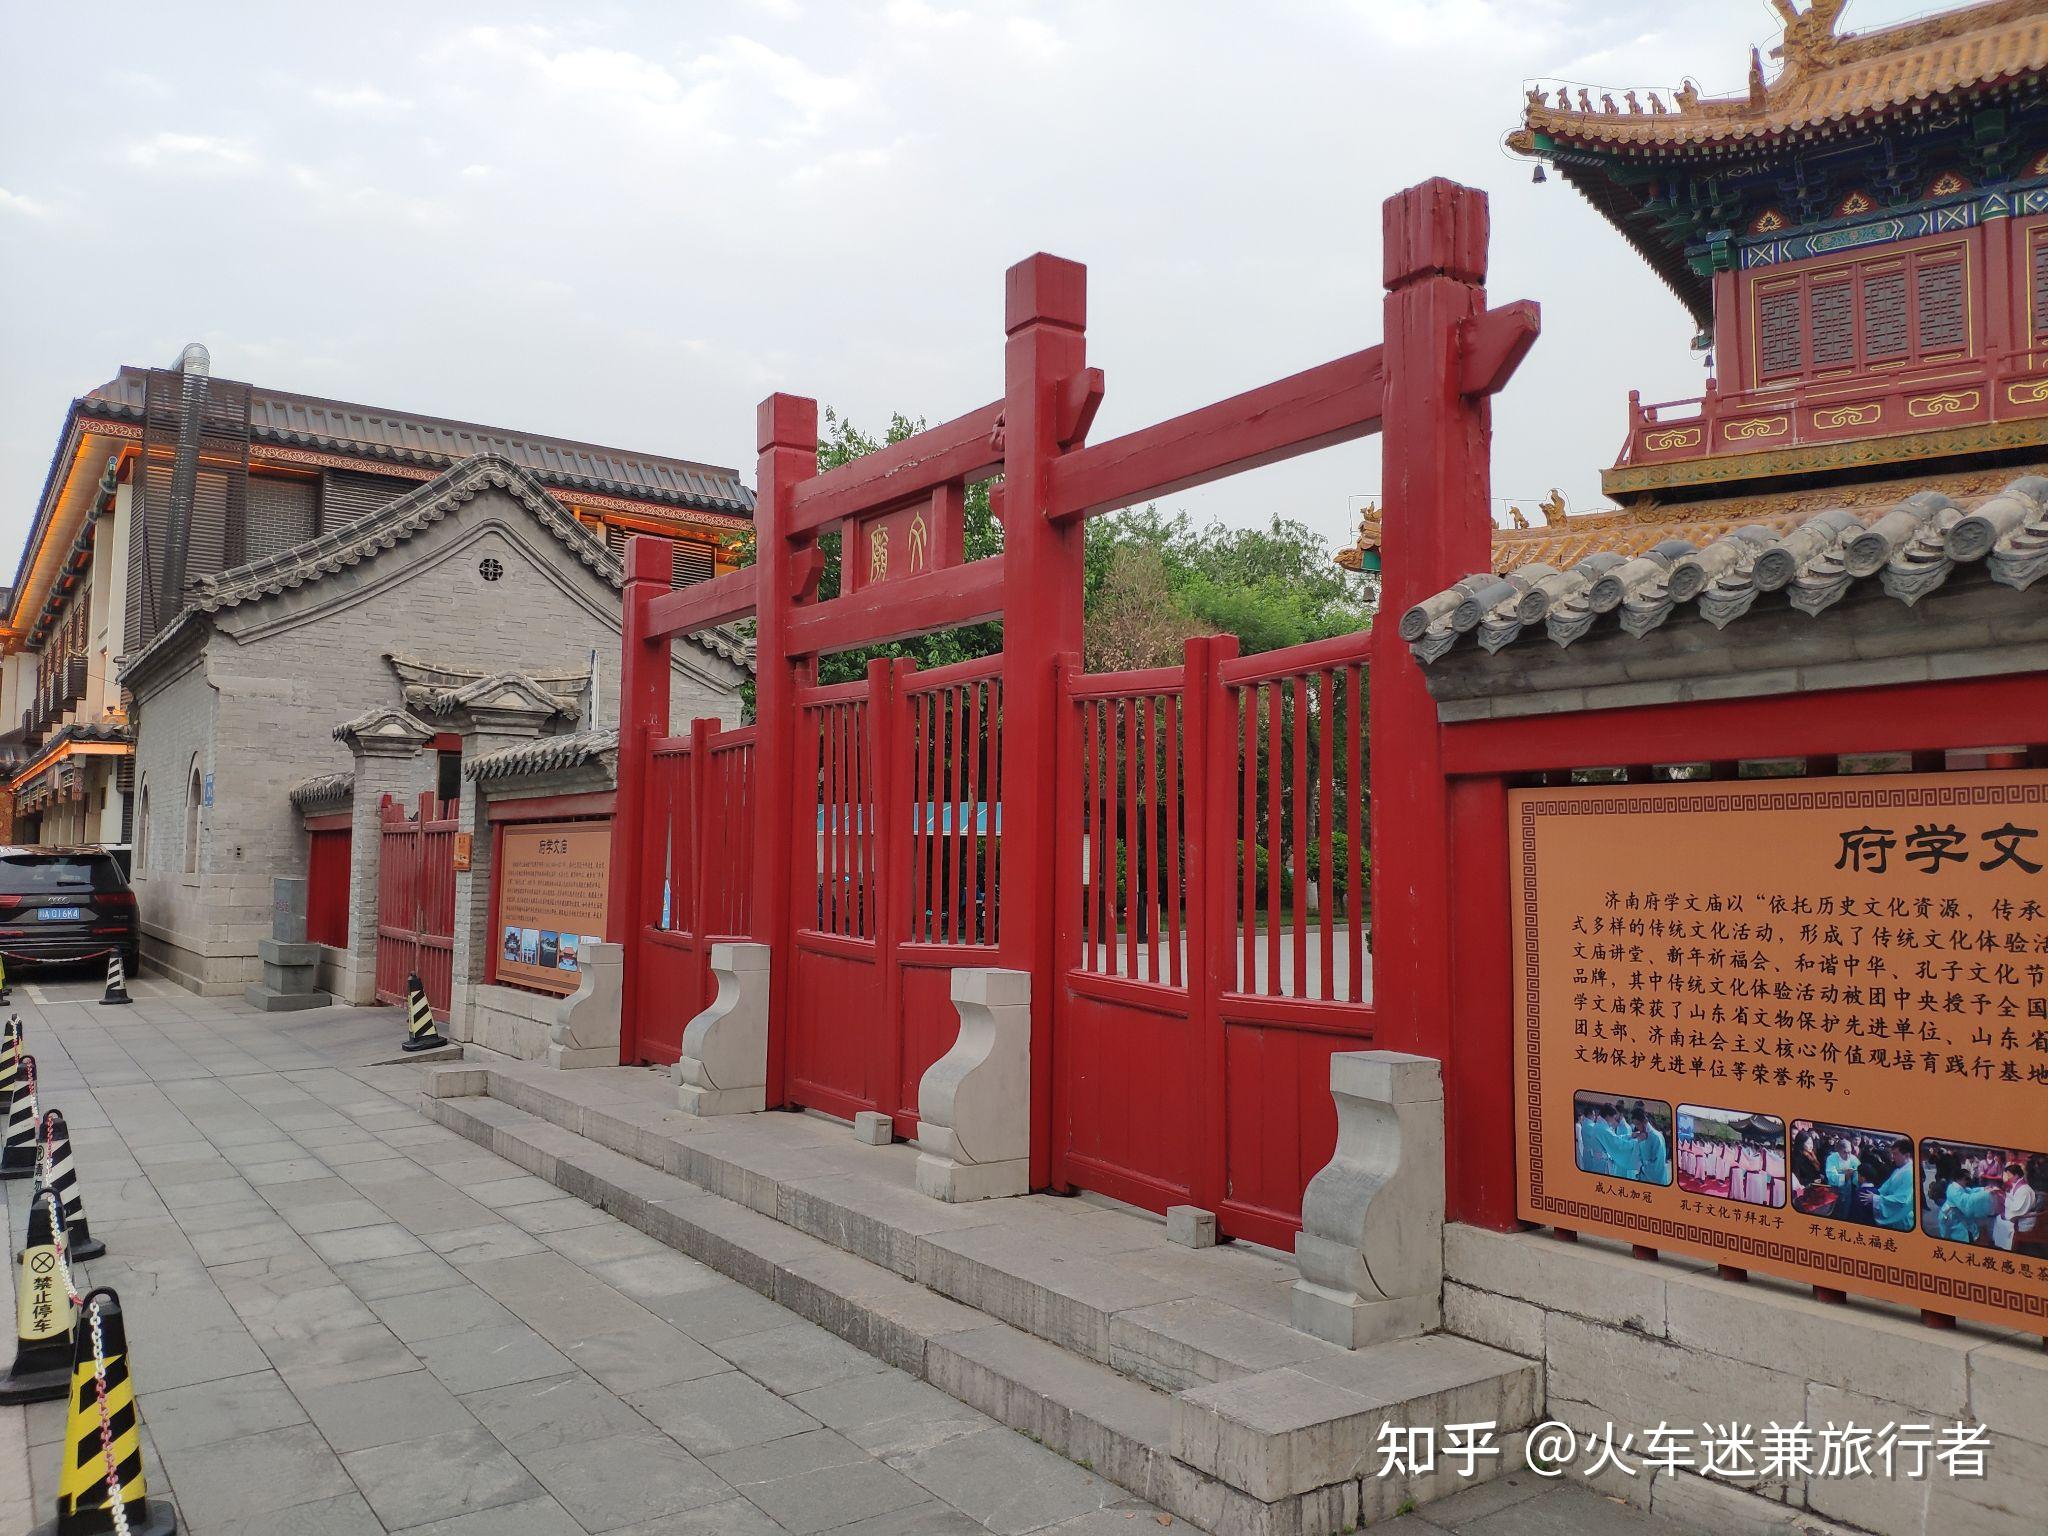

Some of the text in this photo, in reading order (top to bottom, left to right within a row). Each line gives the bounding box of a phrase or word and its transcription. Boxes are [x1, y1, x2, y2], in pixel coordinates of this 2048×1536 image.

[1594, 1181, 1653, 1204] 成人礼加冠
[1680, 1199, 1785, 1230] 孔子文化节拜孔子
[33, 1276, 53, 1332] 禁止停车
